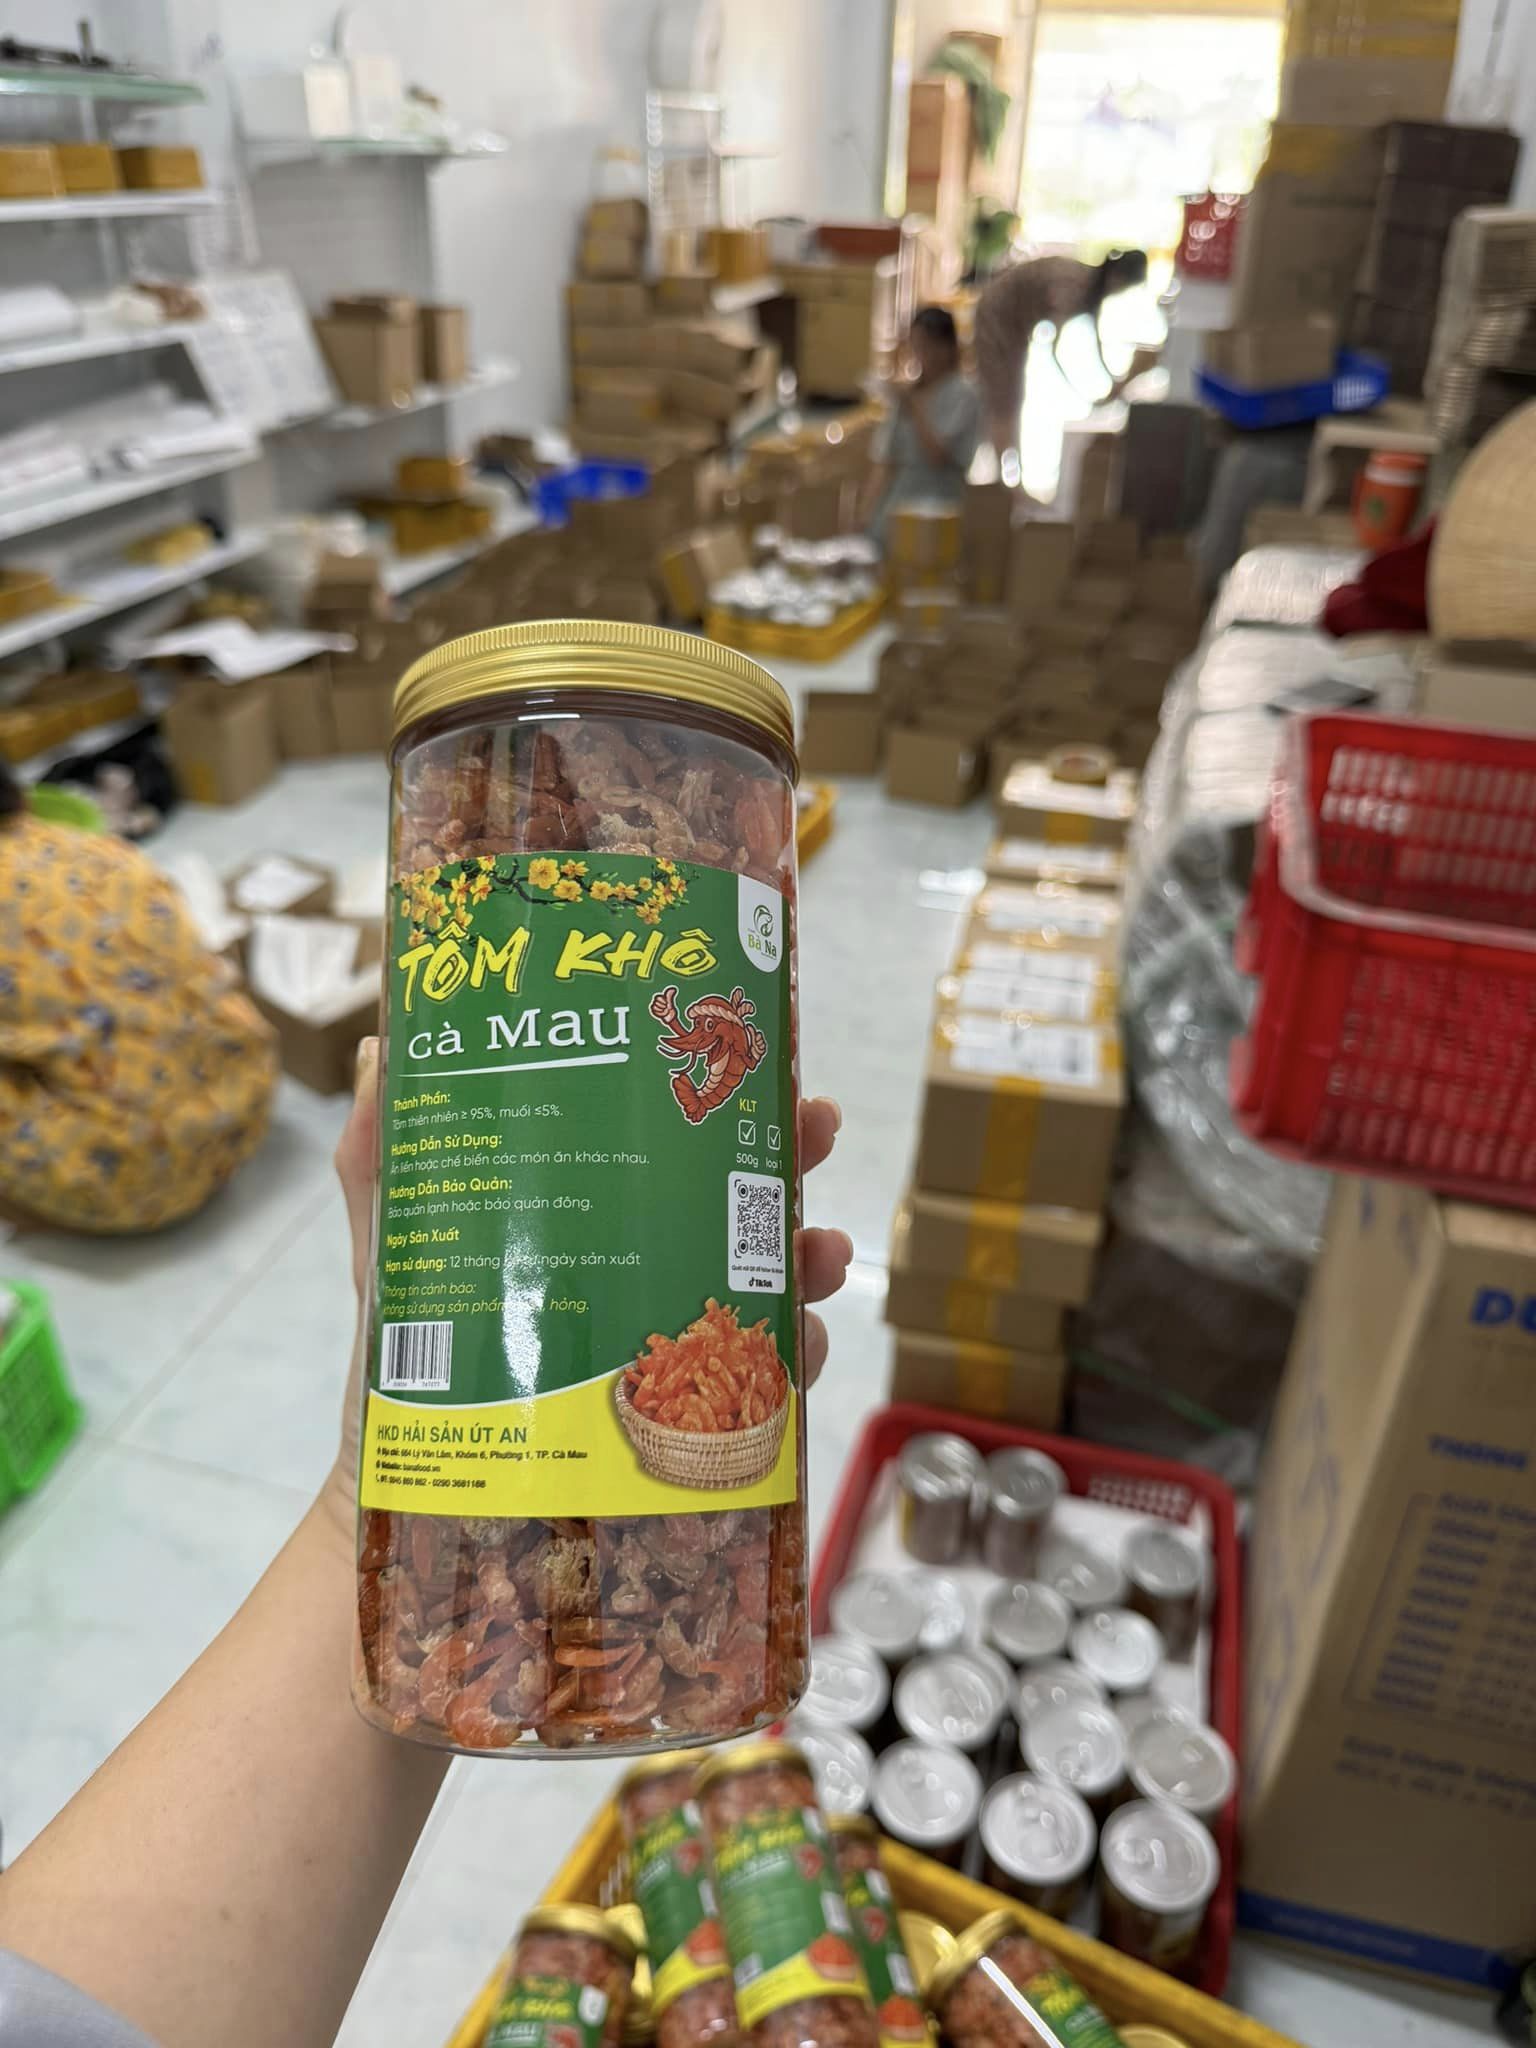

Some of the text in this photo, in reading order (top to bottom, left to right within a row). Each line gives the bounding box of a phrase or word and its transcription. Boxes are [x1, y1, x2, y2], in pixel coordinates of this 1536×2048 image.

[748, 933, 761, 951] Bà
[765, 939, 777, 957] Na
[398, 920, 717, 1012] TÔM KHÔ
[486, 1005, 630, 1050] Mau
[420, 1091, 451, 1106] Phần:
[739, 1098, 758, 1112] KLT
[431, 1110, 458, 1125] nhiên
[470, 1107, 496, 1120] 95%,
[500, 1104, 531, 1118] muối
[420, 1136, 441, 1151] Dẫn
[444, 1134, 461, 1148] Sử
[463, 1134, 503, 1149] Dụng:
[415, 1159, 439, 1173] hoặc
[441, 1154, 461, 1168] chế
[464, 1152, 490, 1166] biến
[492, 1153, 517, 1165] các
[520, 1153, 550, 1164] món
[553, 1152, 572, 1163] ăn
[575, 1151, 609, 1163] khác
[612, 1151, 650, 1164] nhau.
[736, 1152, 758, 1168] 500g
[418, 1179, 439, 1195] Dẫn
[443, 1178, 466, 1193] Bảo
[470, 1176, 512, 1191] Quản:
[404, 1203, 425, 1218] quản
[427, 1201, 449, 1216] lạnh
[451, 1200, 481, 1213] hoặc
[484, 1197, 511, 1211] bảo
[514, 1196, 549, 1212] quản
[553, 1196, 593, 1212] đông.
[386, 1227, 460, 1249] Ngày Sản Xuất
[385, 1259, 401, 1275] Hạn
[402, 1257, 414, 1271] sử
[415, 1257, 447, 1272] dụng:
[450, 1256, 461, 1268] 12
[464, 1255, 500, 1270] tháng
[541, 1252, 577, 1268] ngày
[580, 1252, 606, 1265] sản
[609, 1252, 640, 1265] xuất
[421, 1282, 447, 1296] cảnh
[420, 1302, 446, 1316] dụng
[448, 1300, 469, 1313] sản
[549, 1297, 590, 1314] hỏng.
[377, 1420, 527, 1443] HKD HẢI SẢN ÚT AN
